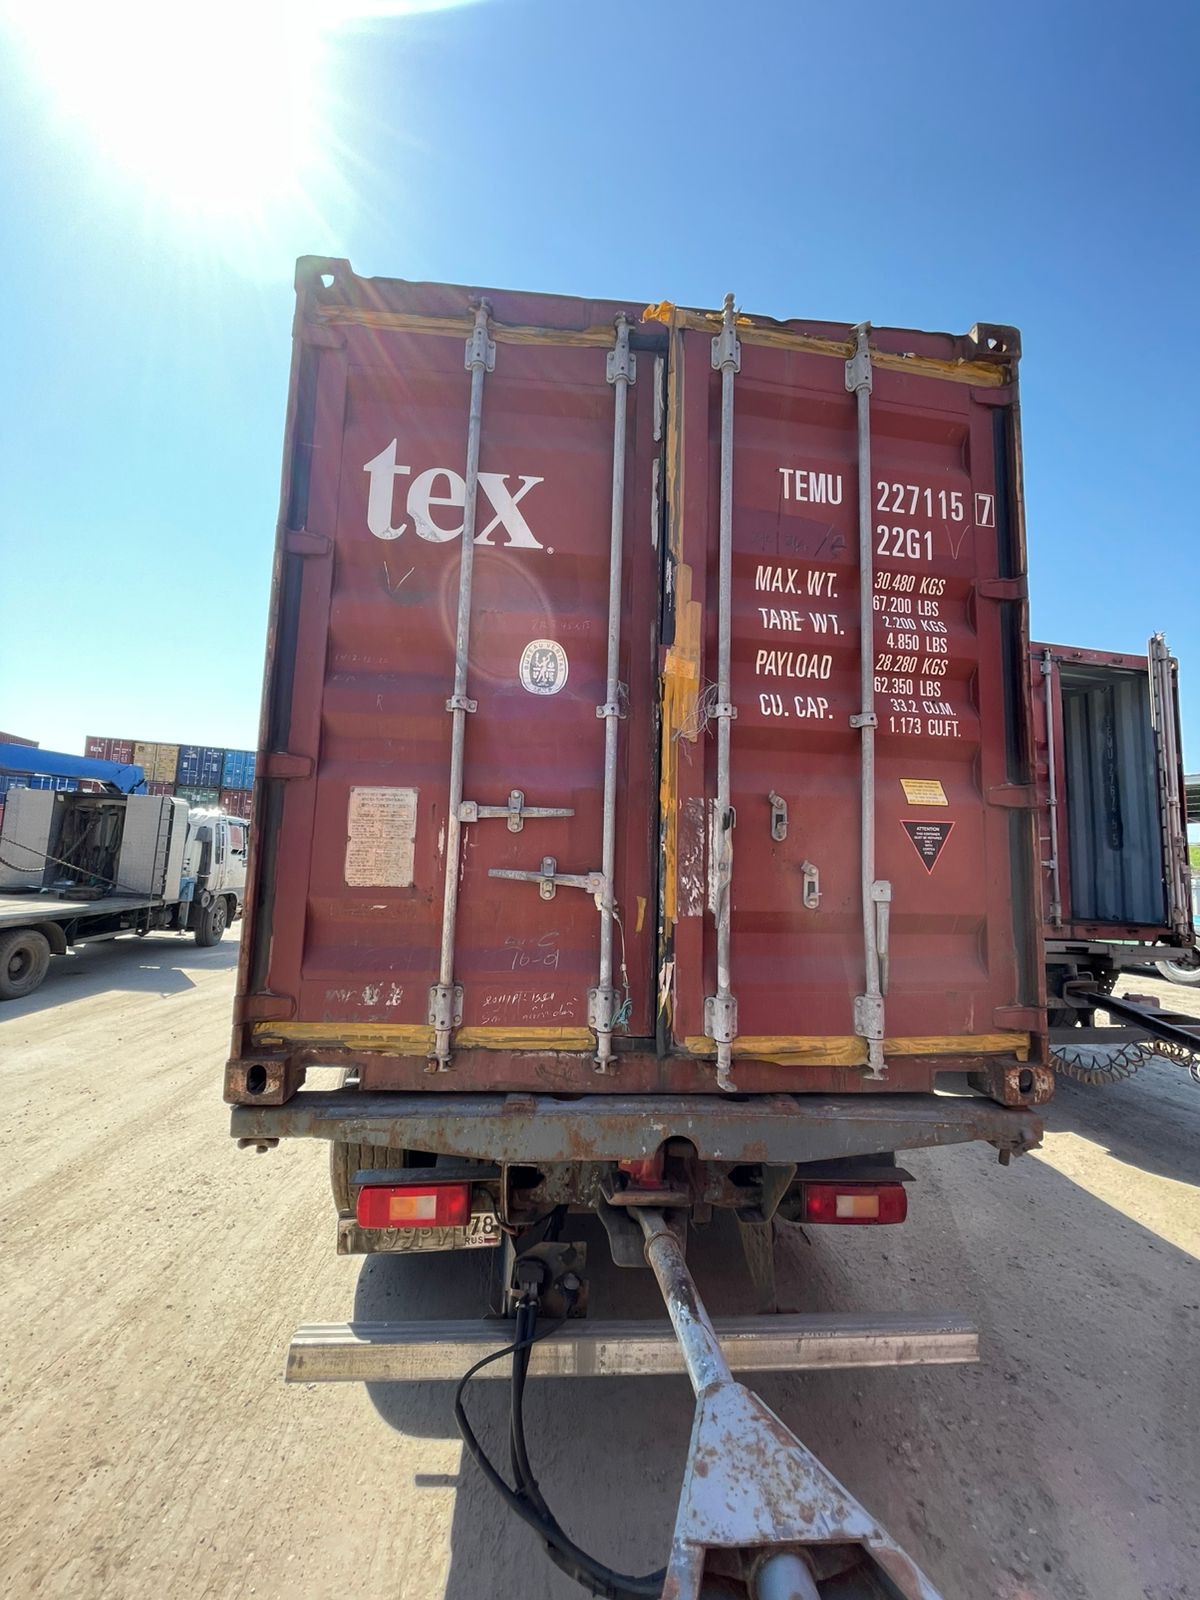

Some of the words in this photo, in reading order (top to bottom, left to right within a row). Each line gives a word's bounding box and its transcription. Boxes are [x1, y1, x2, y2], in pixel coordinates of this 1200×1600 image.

[779, 468, 842, 505] TEMU
[877, 481, 963, 521] 227115
[980, 495, 992, 525] 7
[877, 525, 933, 560] 22G1
[755, 566, 802, 594] MAX.
[807, 570, 838, 597] WT.
[874, 572, 915, 592] 30.480
[919, 577, 946, 596] KGS
[873, 596, 912, 614] 67.200
[918, 600, 939, 617] LBS
[758, 608, 804, 631] TARE
[809, 613, 845, 634] WT.
[882, 616, 916, 630] 2.200
[921, 619, 948, 633] KGS
[887, 633, 919, 651] 4.850
[926, 636, 948, 653] LBS
[755, 650, 832, 680] PAYLOAD
[875, 654, 917, 673] 28.280
[921, 659, 948, 676] KGS
[874, 677, 913, 695] 62.350
[920, 680, 941, 697] LBS
[759, 693, 789, 716] CU.
[794, 696, 833, 719] CAP.
[890, 698, 919, 713] 33.2
[890, 716, 921, 734] 1.173
[928, 720, 961, 737] CU.FT.
[464, 1236, 484, 1245] RUS
